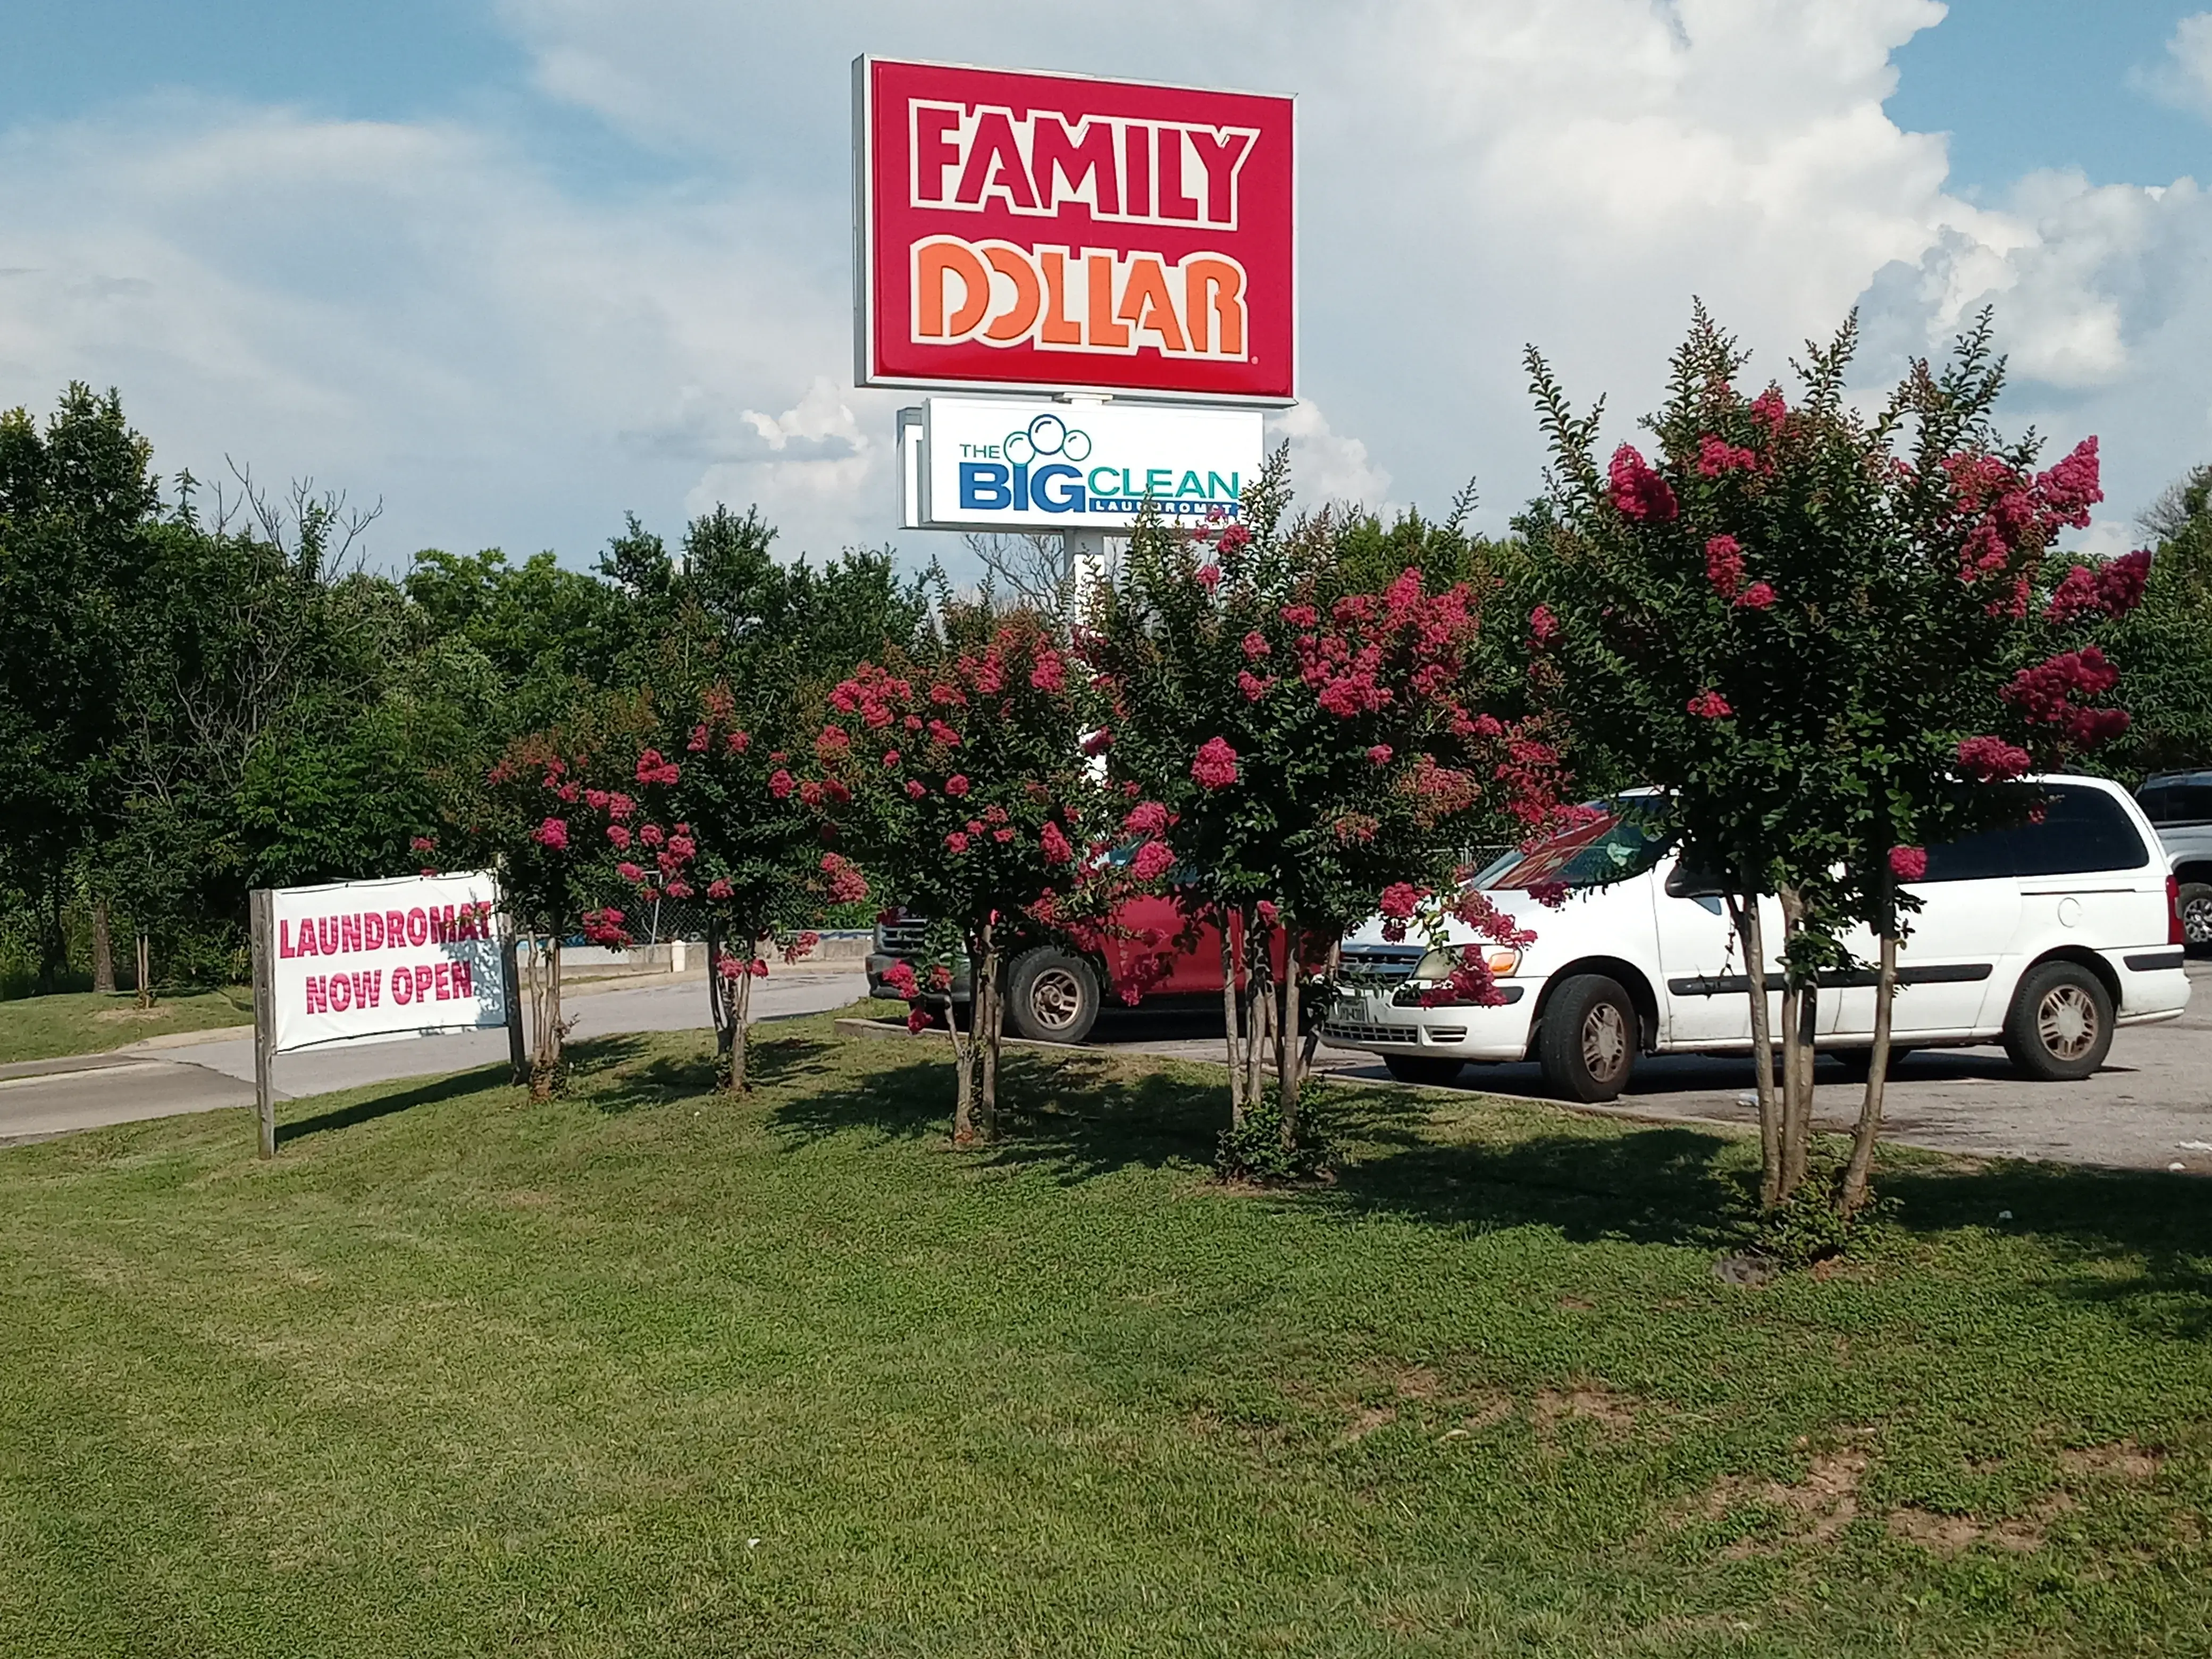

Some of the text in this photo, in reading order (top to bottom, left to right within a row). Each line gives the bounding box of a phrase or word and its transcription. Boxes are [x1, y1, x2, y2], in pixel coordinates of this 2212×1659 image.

[908, 98, 1261, 231] FAMILY
[910, 234, 1248, 362] DOLLAR
[959, 443, 1000, 459] THE
[959, 462, 1238, 513] BIG CLEAN
[280, 901, 490, 958] LAUNDROMAT
[306, 960, 472, 1014] NOW OPEN
